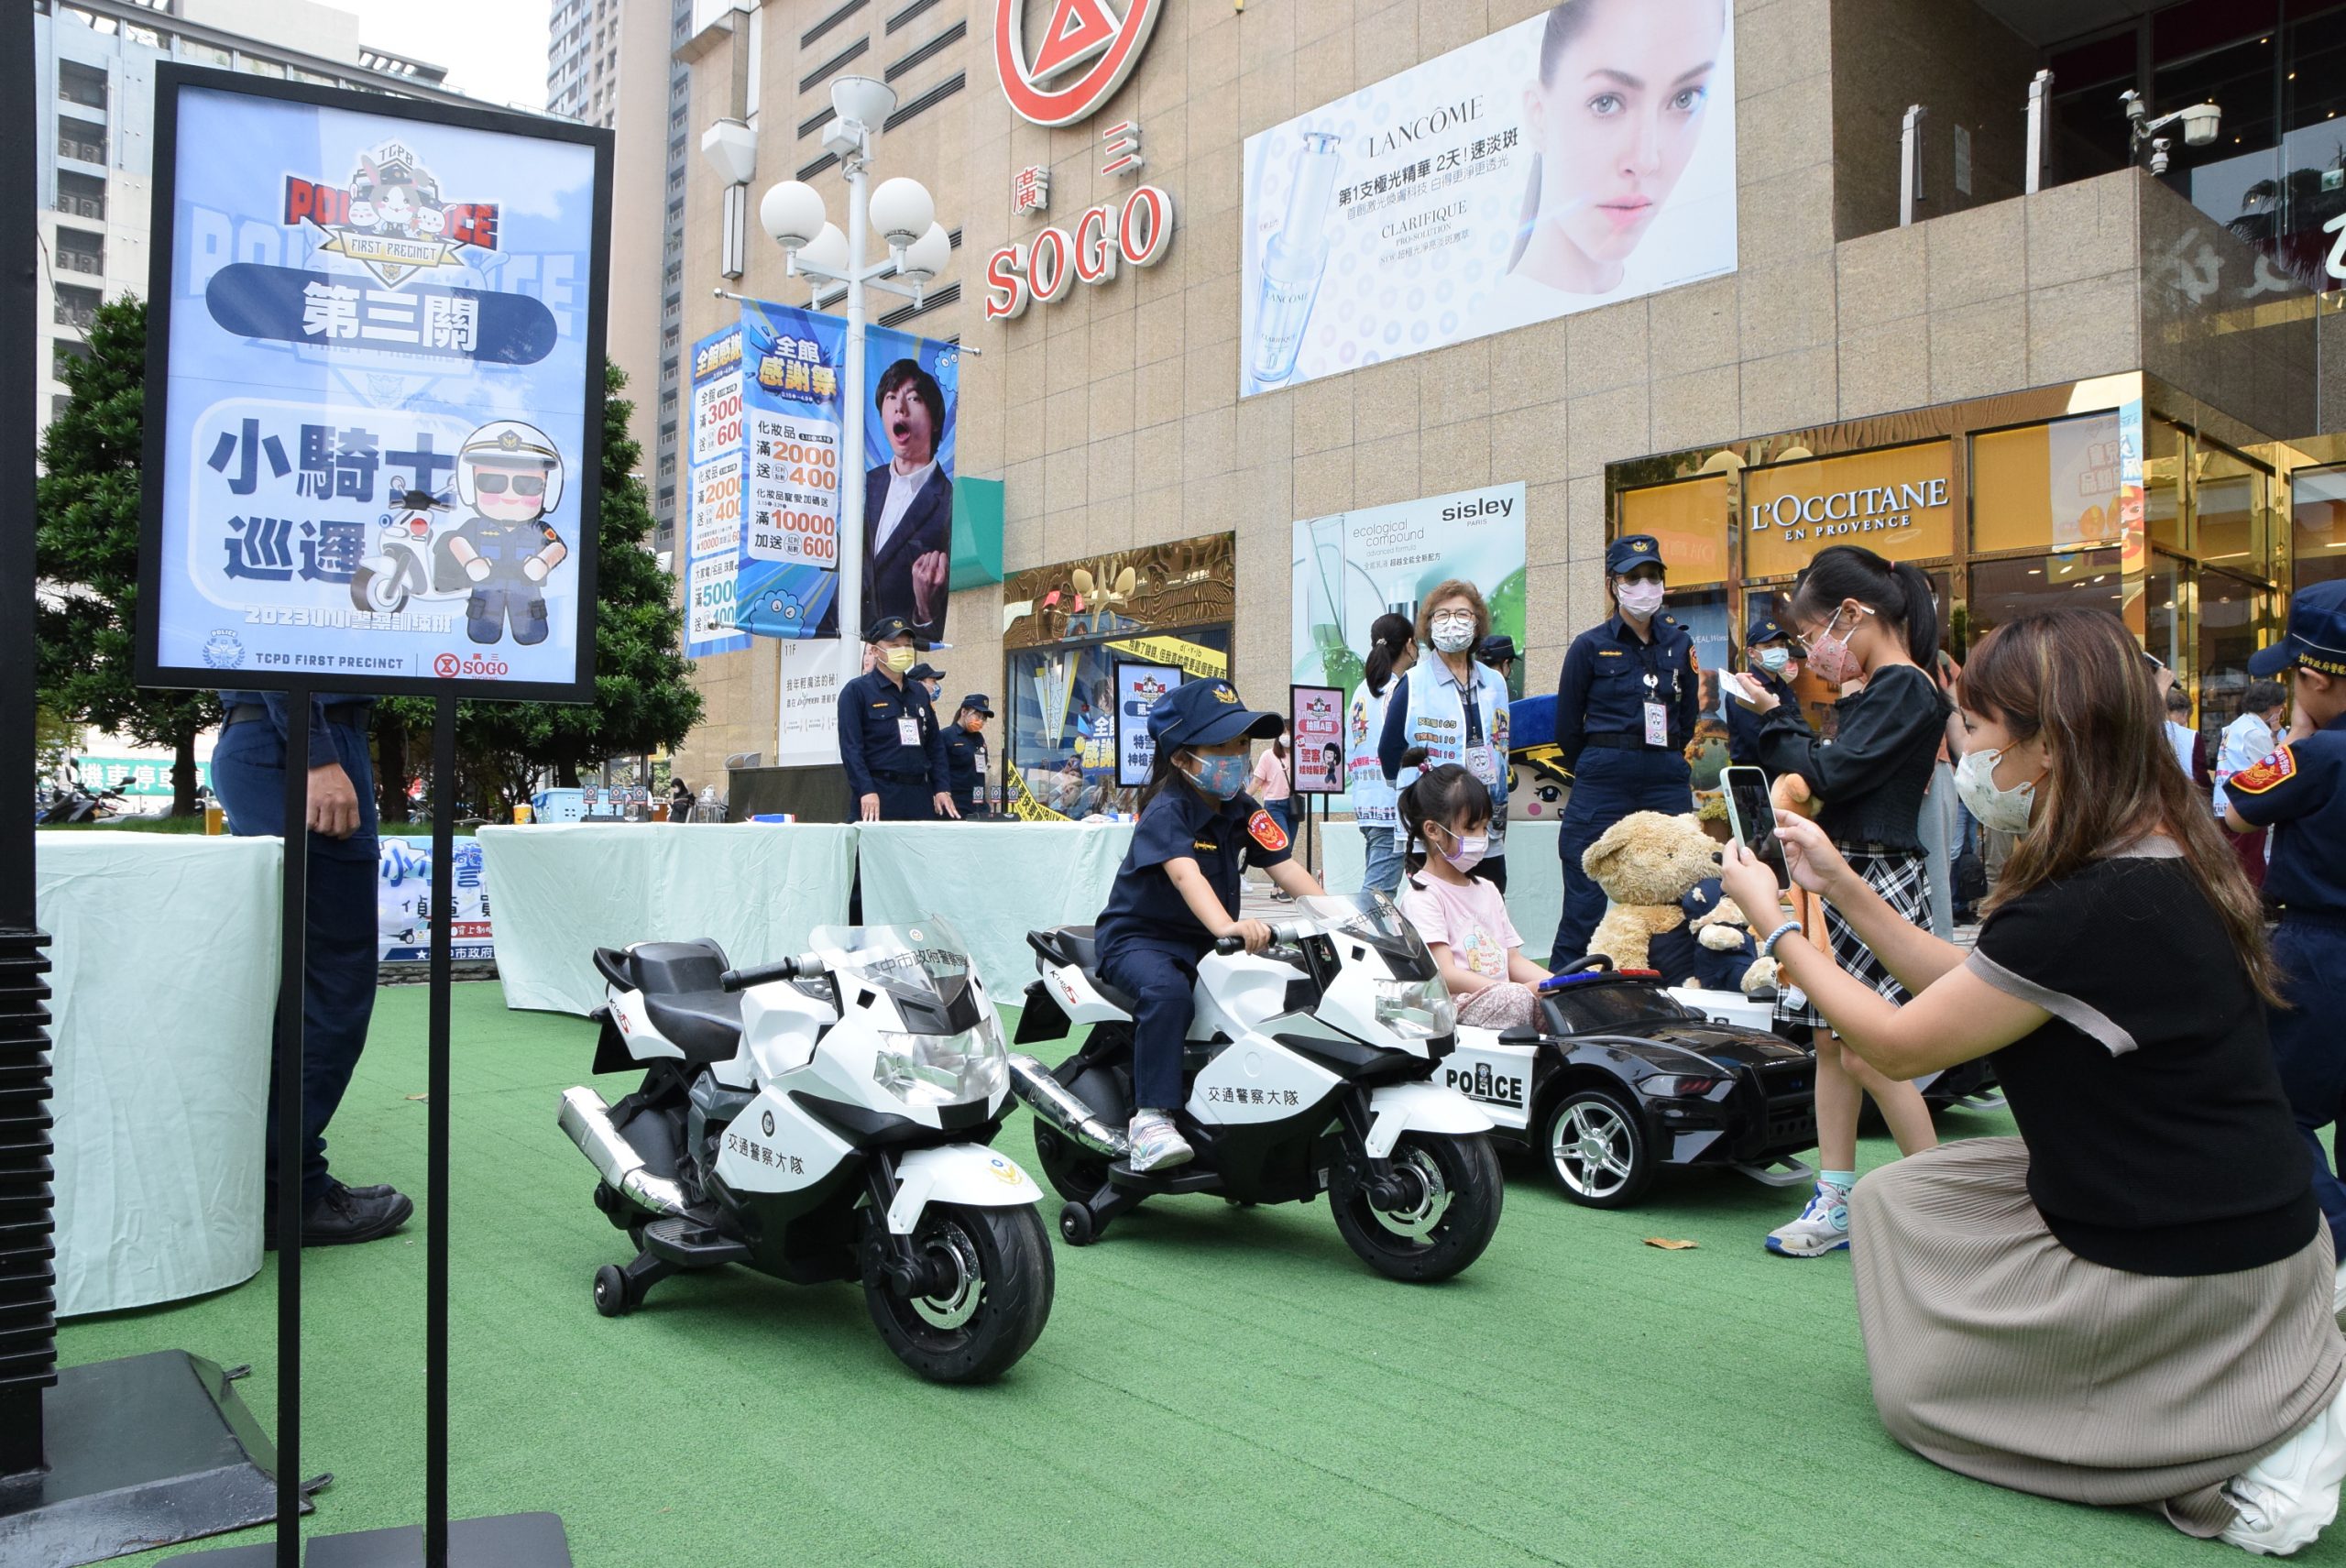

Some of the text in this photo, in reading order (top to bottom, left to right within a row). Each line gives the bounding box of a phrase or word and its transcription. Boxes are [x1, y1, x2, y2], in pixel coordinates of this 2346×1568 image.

[1369, 93, 1484, 159] LANCÔME
[1338, 159, 1431, 207] 第1支極光精華
[1381, 200, 1466, 238] CLARIFIQUE
[352, 238, 436, 260] FIRST PRECINCT
[986, 185, 1172, 321] SOGO
[302, 281, 479, 353] 第三關
[774, 335, 820, 363] 全館
[759, 356, 837, 396] 感謝祭
[207, 418, 456, 505] 小騎士
[789, 466, 836, 490] 400
[1442, 498, 1514, 521] sisley
[1751, 477, 1949, 531] L'OCCITANE
[1354, 519, 1408, 538] ecological
[1466, 519, 1487, 527] PARIS
[1785, 515, 1912, 541] EN PROVENCE
[224, 516, 366, 584] 巡邏
[803, 536, 835, 559] 600
[1366, 528, 1424, 548] compound
[211, 628, 238, 639] POLICE
[256, 653, 403, 669] TCPD FIRST PRECINCT
[785, 644, 796, 656] 11F
[463, 661, 509, 675] SOGO
[1446, 1063, 1522, 1101] POLICE
[1209, 1087, 1299, 1105] 交通警察大隊
[728, 1133, 805, 1175] 交通警察大隊
